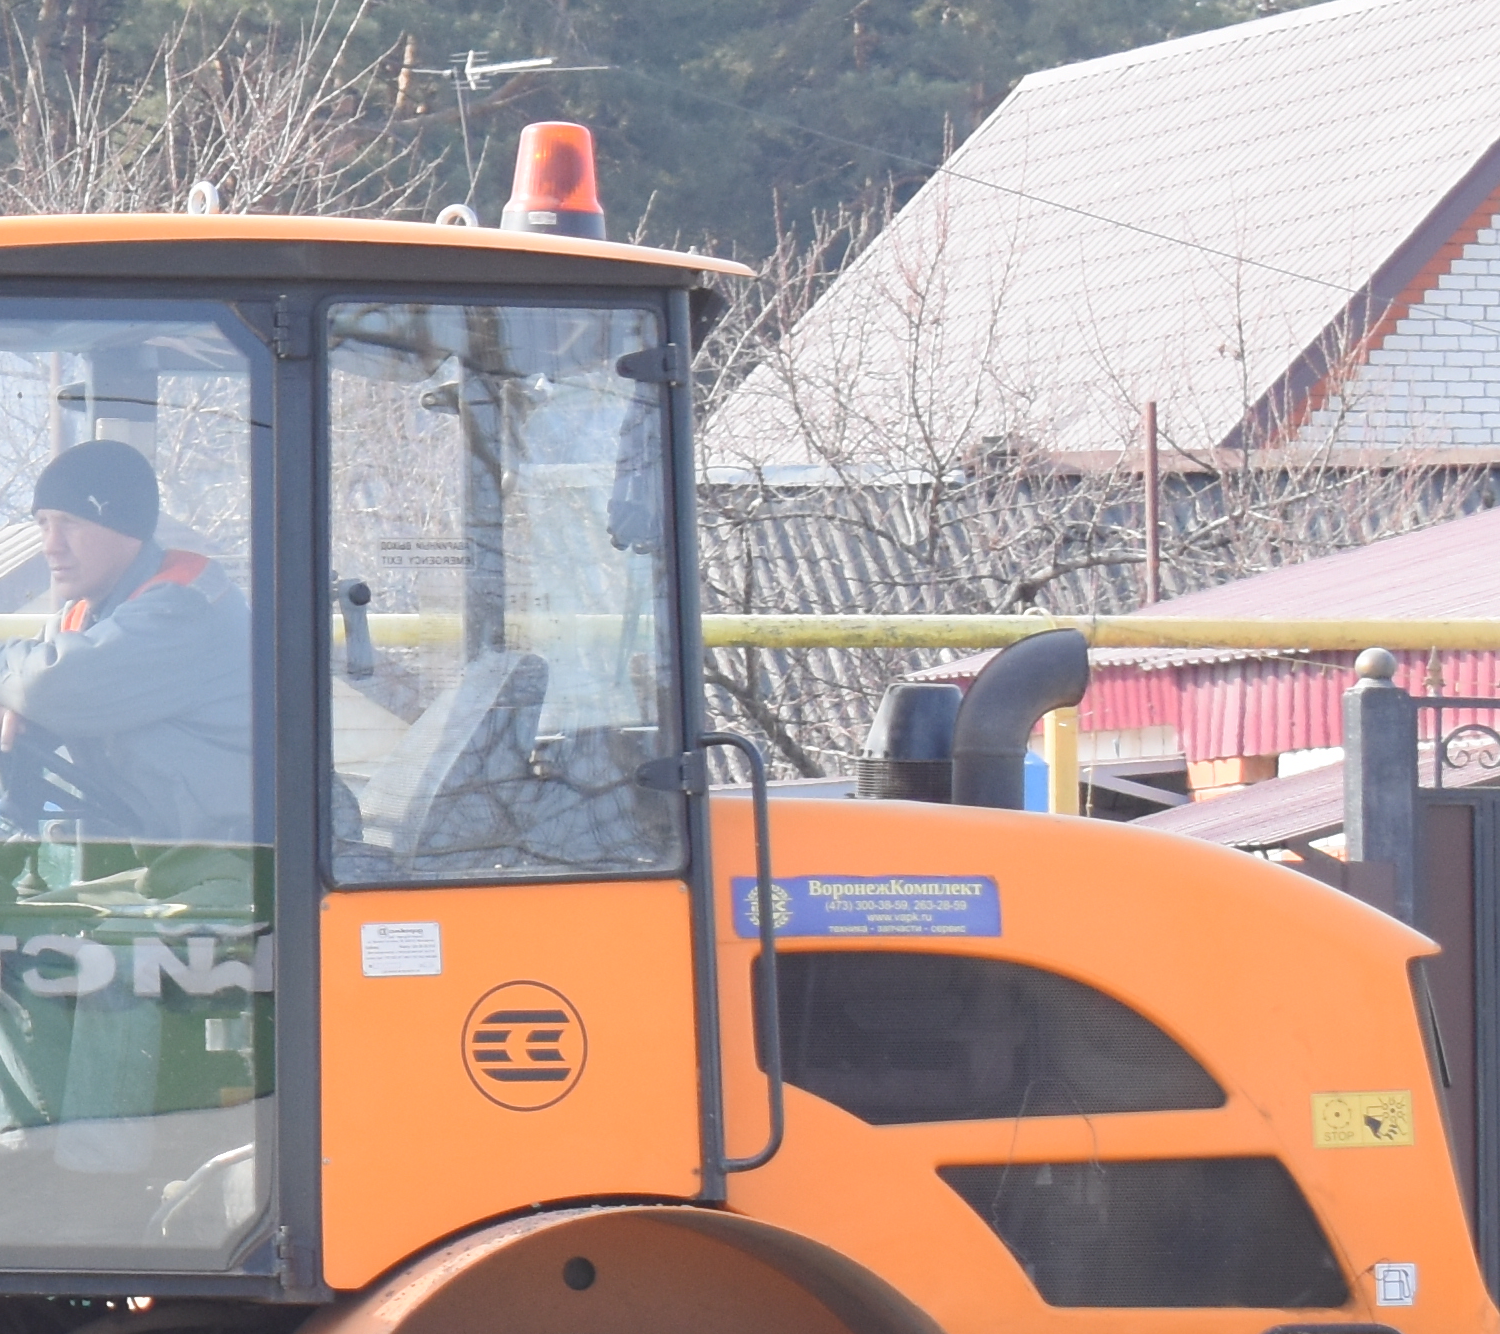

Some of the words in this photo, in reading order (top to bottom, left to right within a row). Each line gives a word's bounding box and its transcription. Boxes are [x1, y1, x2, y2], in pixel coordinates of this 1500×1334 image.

[808, 879, 983, 898] ВоронежКомплект
[825, 900, 854, 913] (473)
[855, 900, 910, 912] 300-38-59,
[1324, 1130, 1355, 1142] STOP
